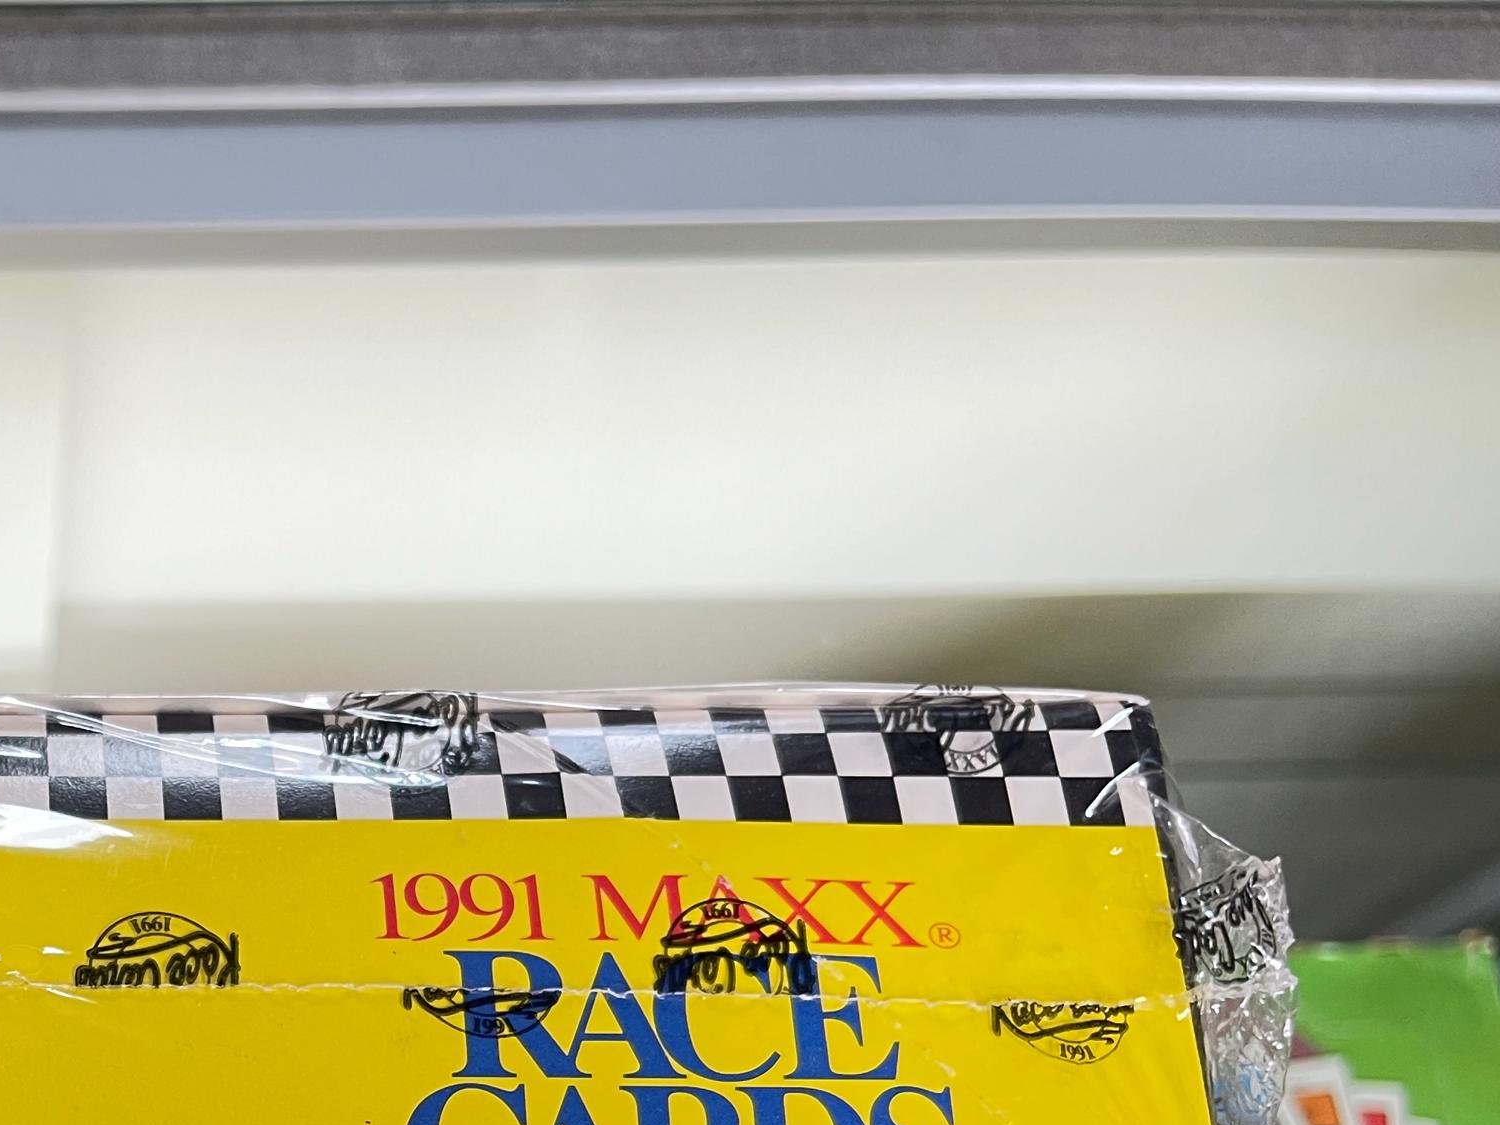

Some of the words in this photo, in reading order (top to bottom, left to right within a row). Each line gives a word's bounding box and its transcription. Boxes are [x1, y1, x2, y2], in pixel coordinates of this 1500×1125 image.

[370, 873, 555, 942] 1991
[699, 902, 741, 920] 1991
[129, 916, 172, 934] 1991
[443, 949, 900, 1083] RACE
[472, 1017, 516, 1035] 1991
[1060, 1043, 1097, 1061] 1991
